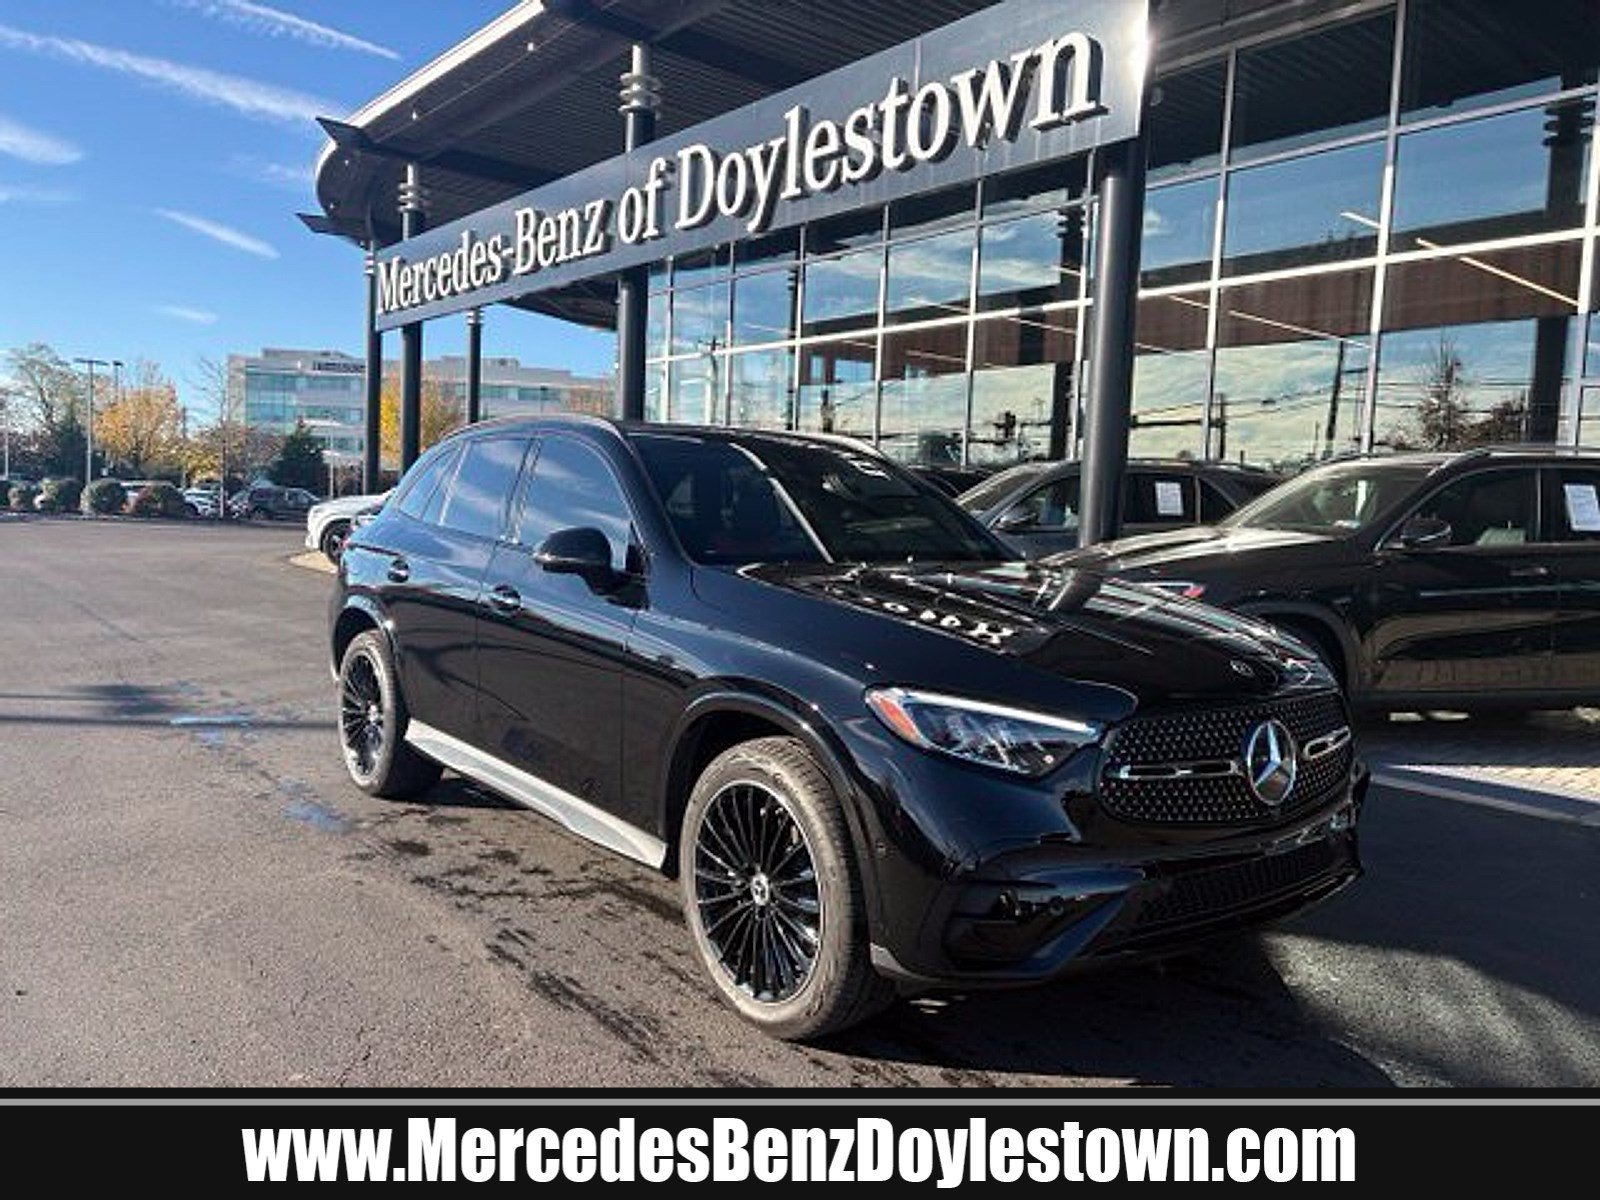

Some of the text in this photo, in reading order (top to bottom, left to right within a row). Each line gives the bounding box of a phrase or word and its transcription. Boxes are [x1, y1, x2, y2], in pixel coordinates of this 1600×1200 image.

[375, 29, 1102, 315] Mercedes-Benz of Doylestown
